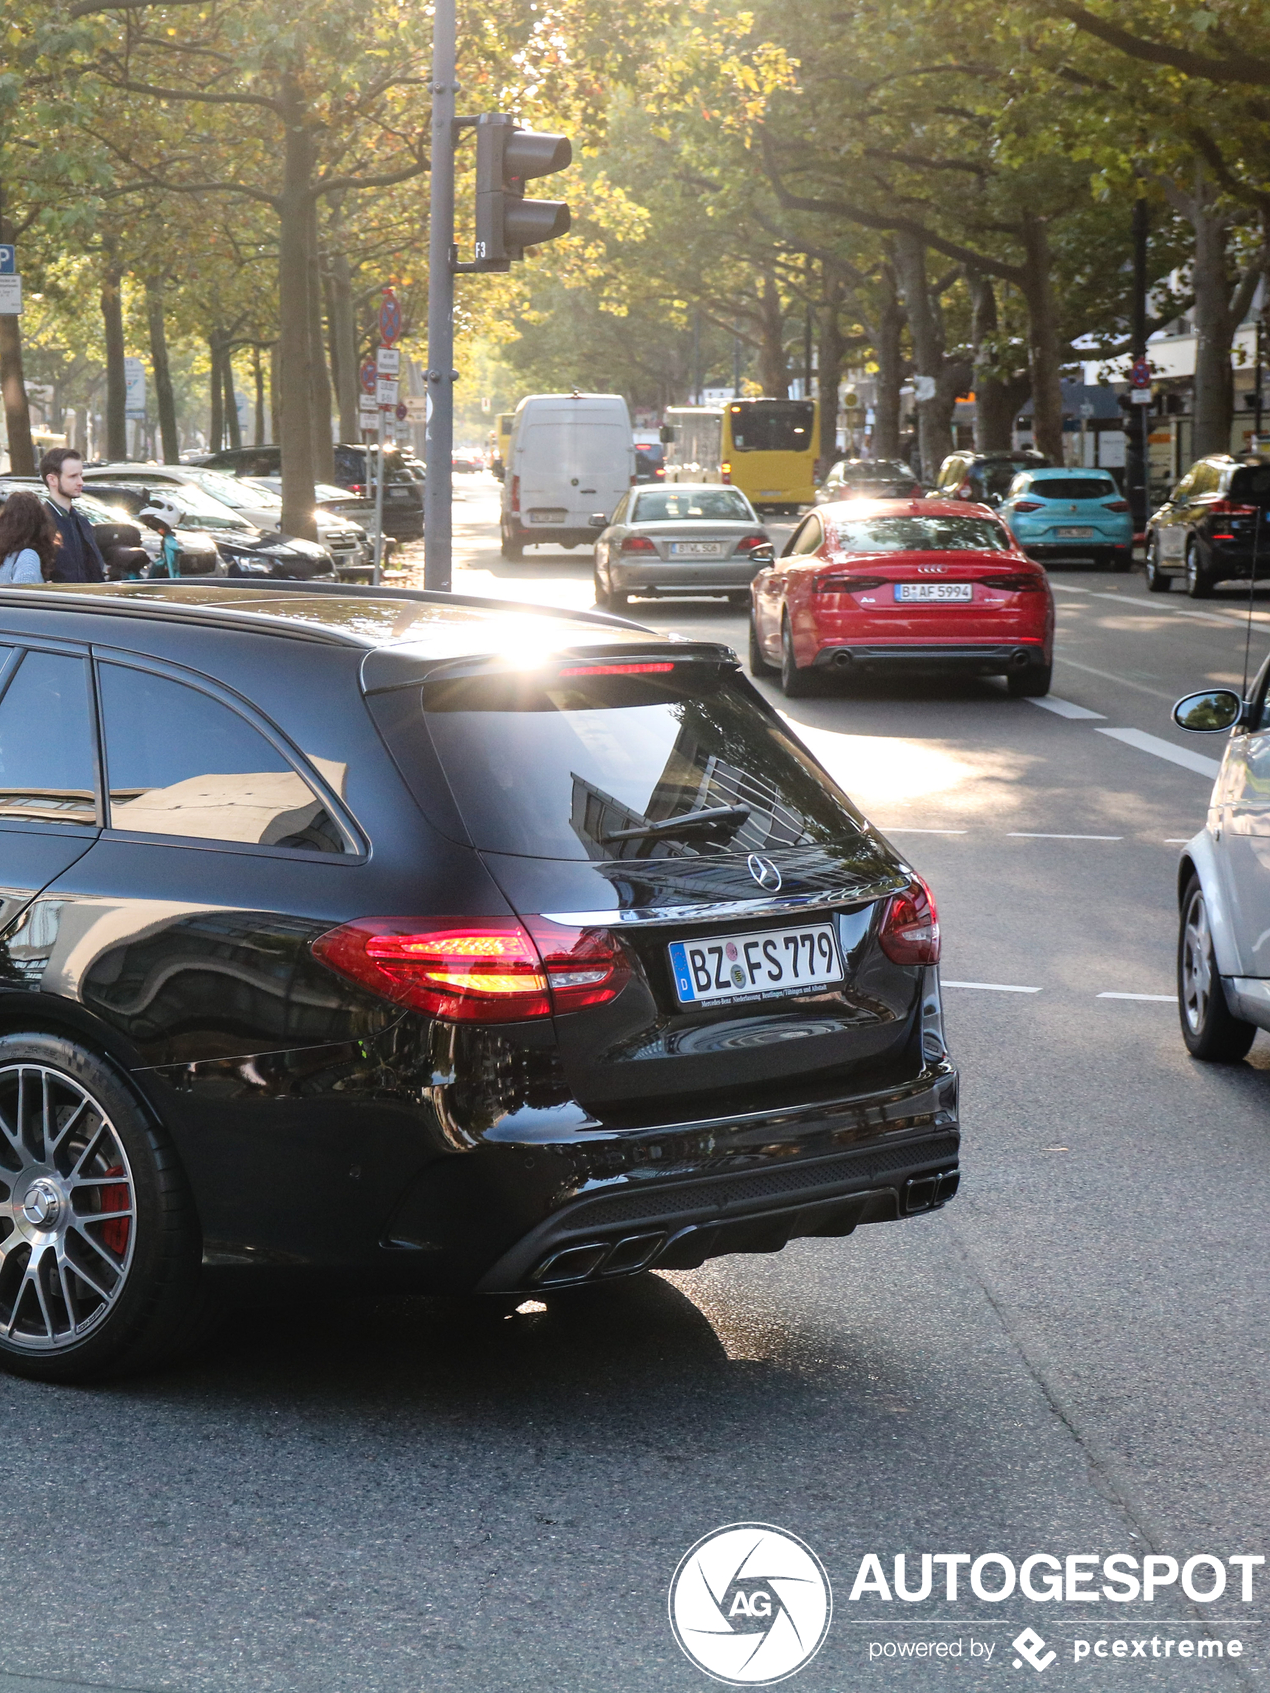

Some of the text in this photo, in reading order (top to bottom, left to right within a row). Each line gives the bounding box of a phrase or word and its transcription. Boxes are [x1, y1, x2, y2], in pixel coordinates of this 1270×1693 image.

[475, 241, 486, 259] F3
[902, 585, 969, 598] B AF 5994
[689, 932, 832, 992] BZ FS 779
[680, 978, 688, 991] D
